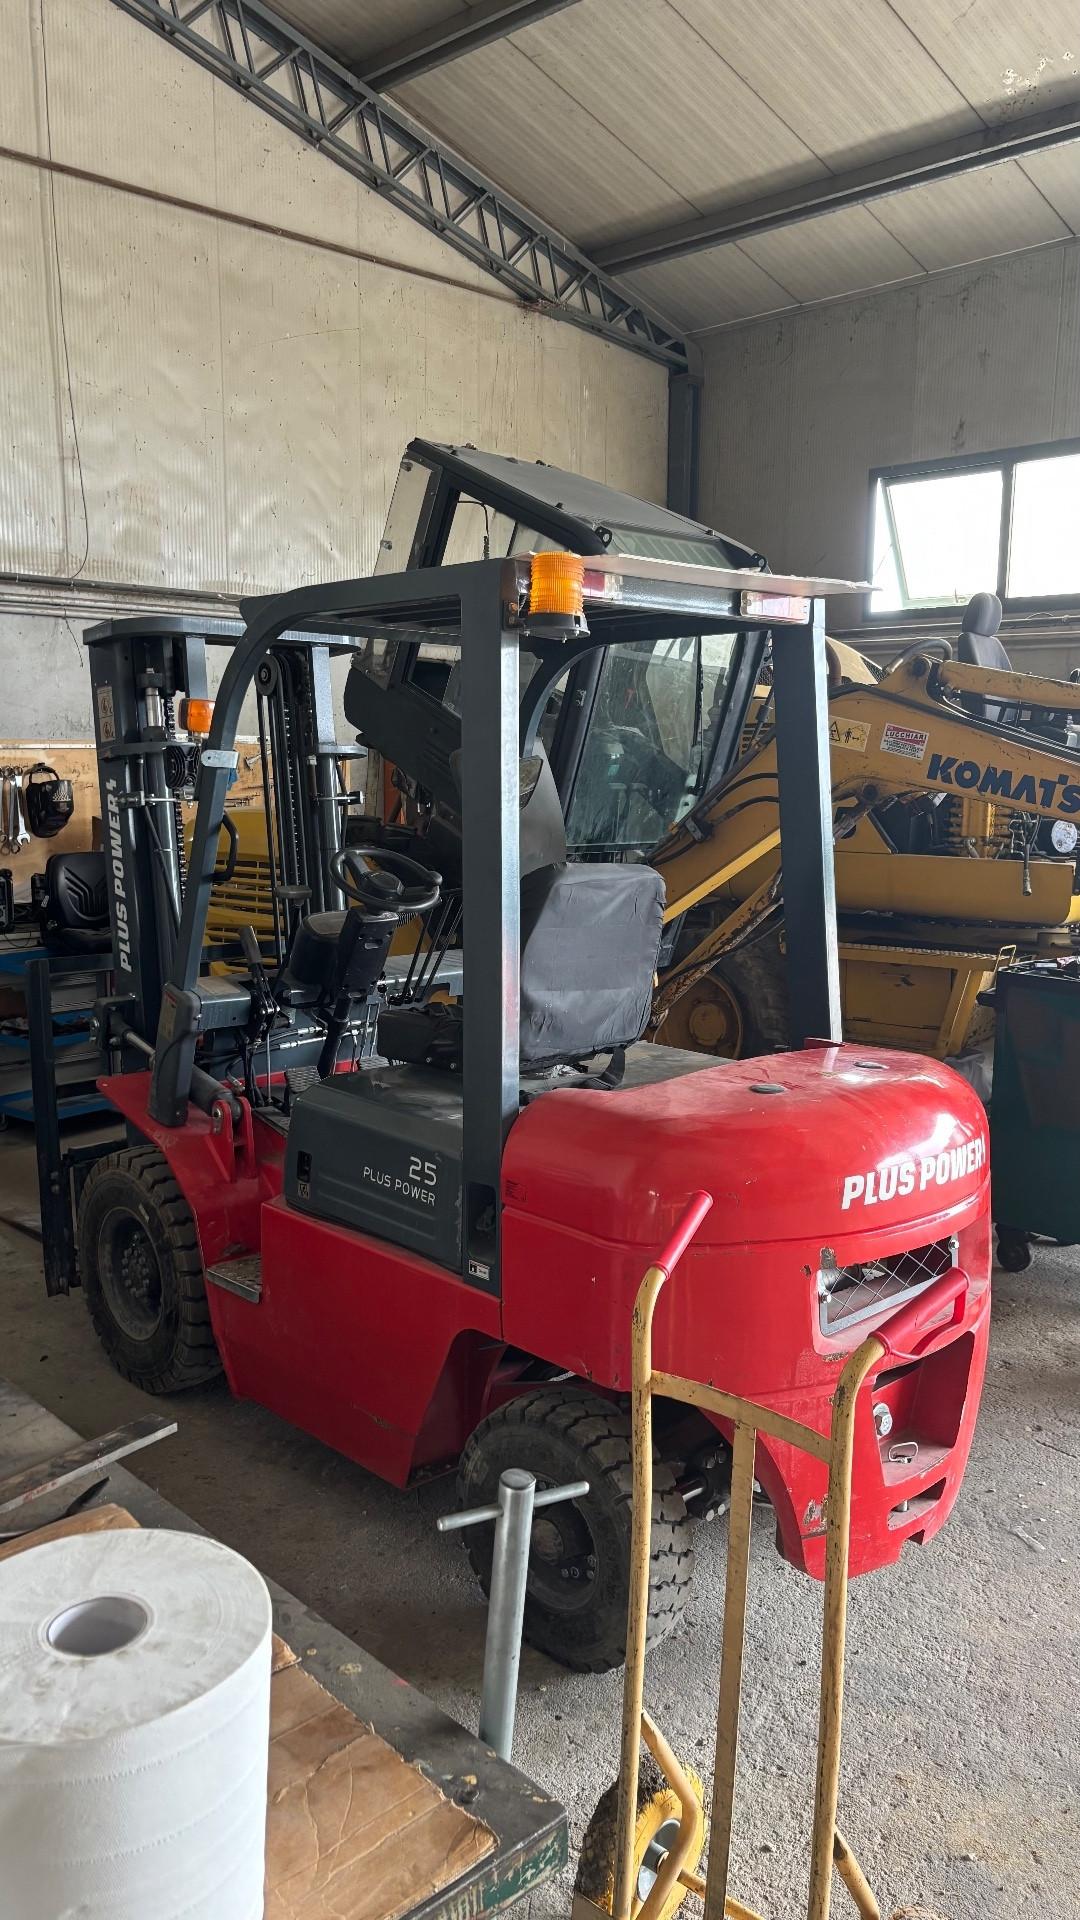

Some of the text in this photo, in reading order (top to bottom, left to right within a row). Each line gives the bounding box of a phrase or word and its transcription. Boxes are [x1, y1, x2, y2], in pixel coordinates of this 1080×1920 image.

[107, 793, 132, 973] PLUS POWER
[363, 1166, 436, 1207] PLUS POWER
[409, 1156, 437, 1186] 25
[841, 1139, 983, 1210] PLUS POWER
